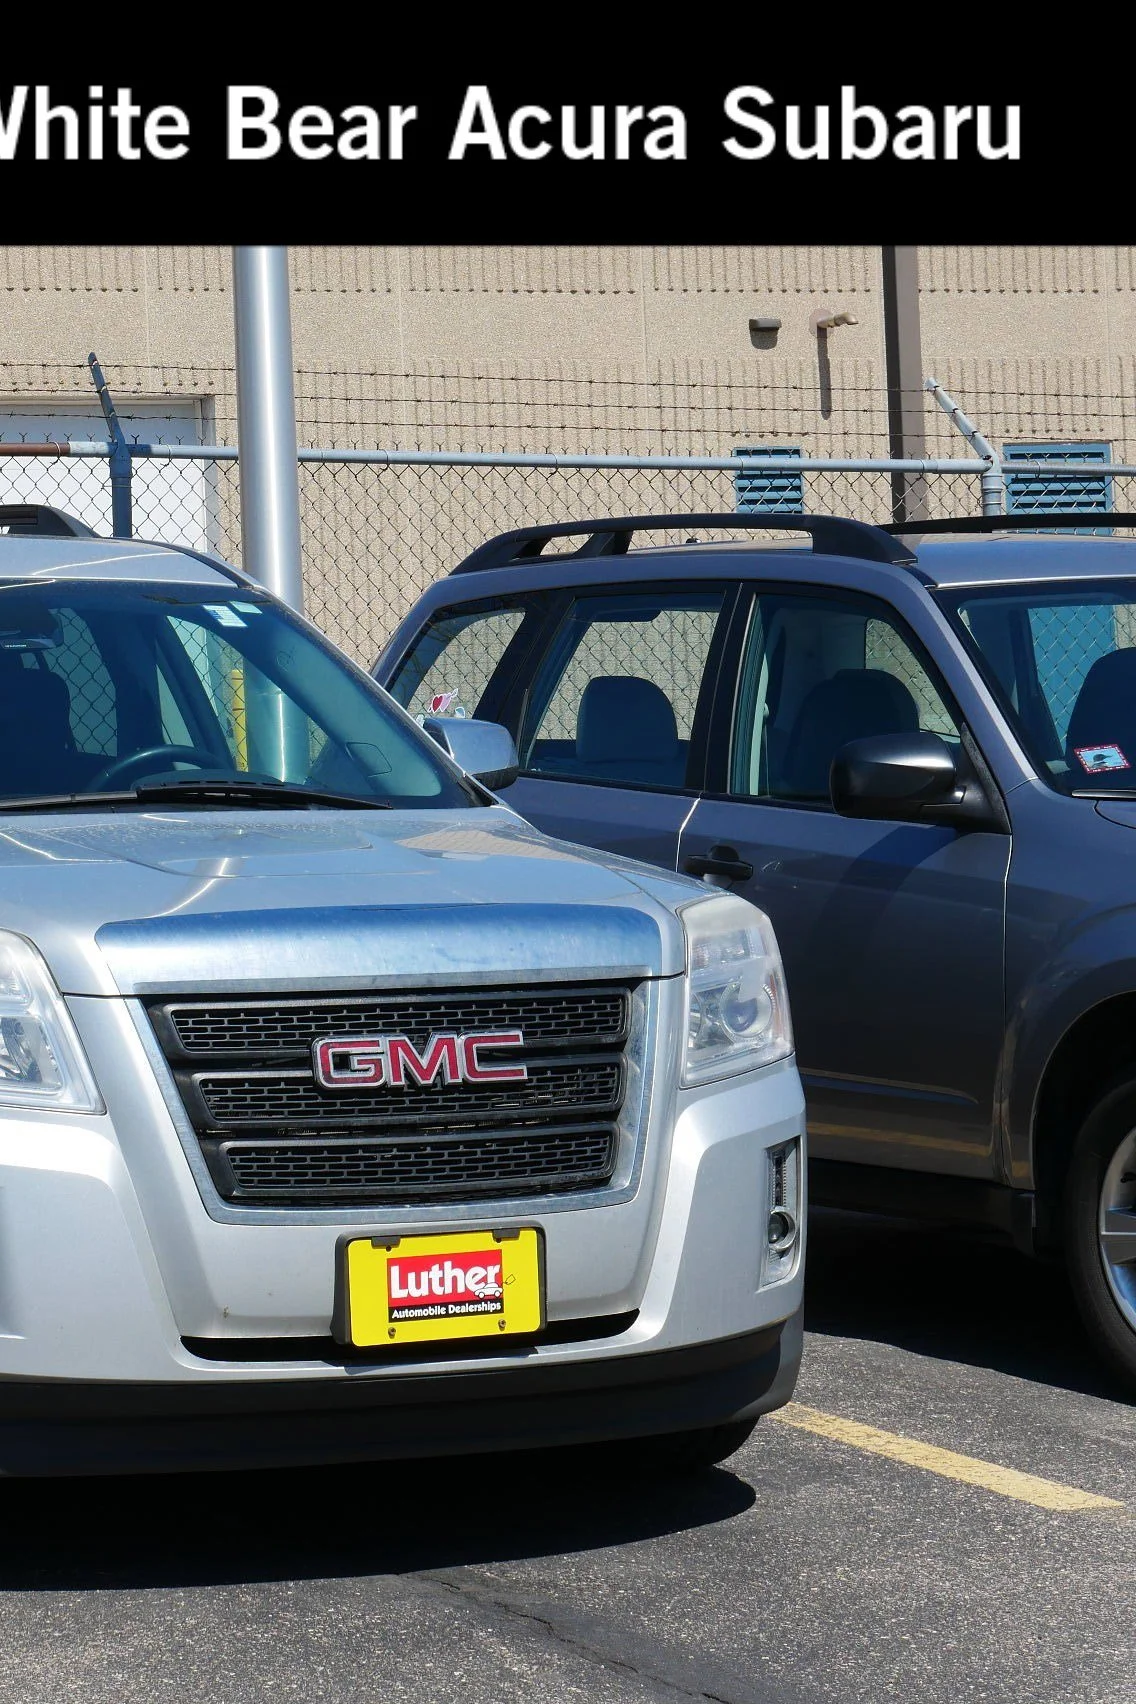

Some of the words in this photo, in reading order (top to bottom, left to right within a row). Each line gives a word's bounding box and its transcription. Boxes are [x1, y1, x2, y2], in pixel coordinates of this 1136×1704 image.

[312, 1029, 528, 1088] GMC
[390, 1260, 501, 1299] Luther
[392, 1304, 446, 1319] Automobile
[448, 1301, 501, 1314] Dealerships
